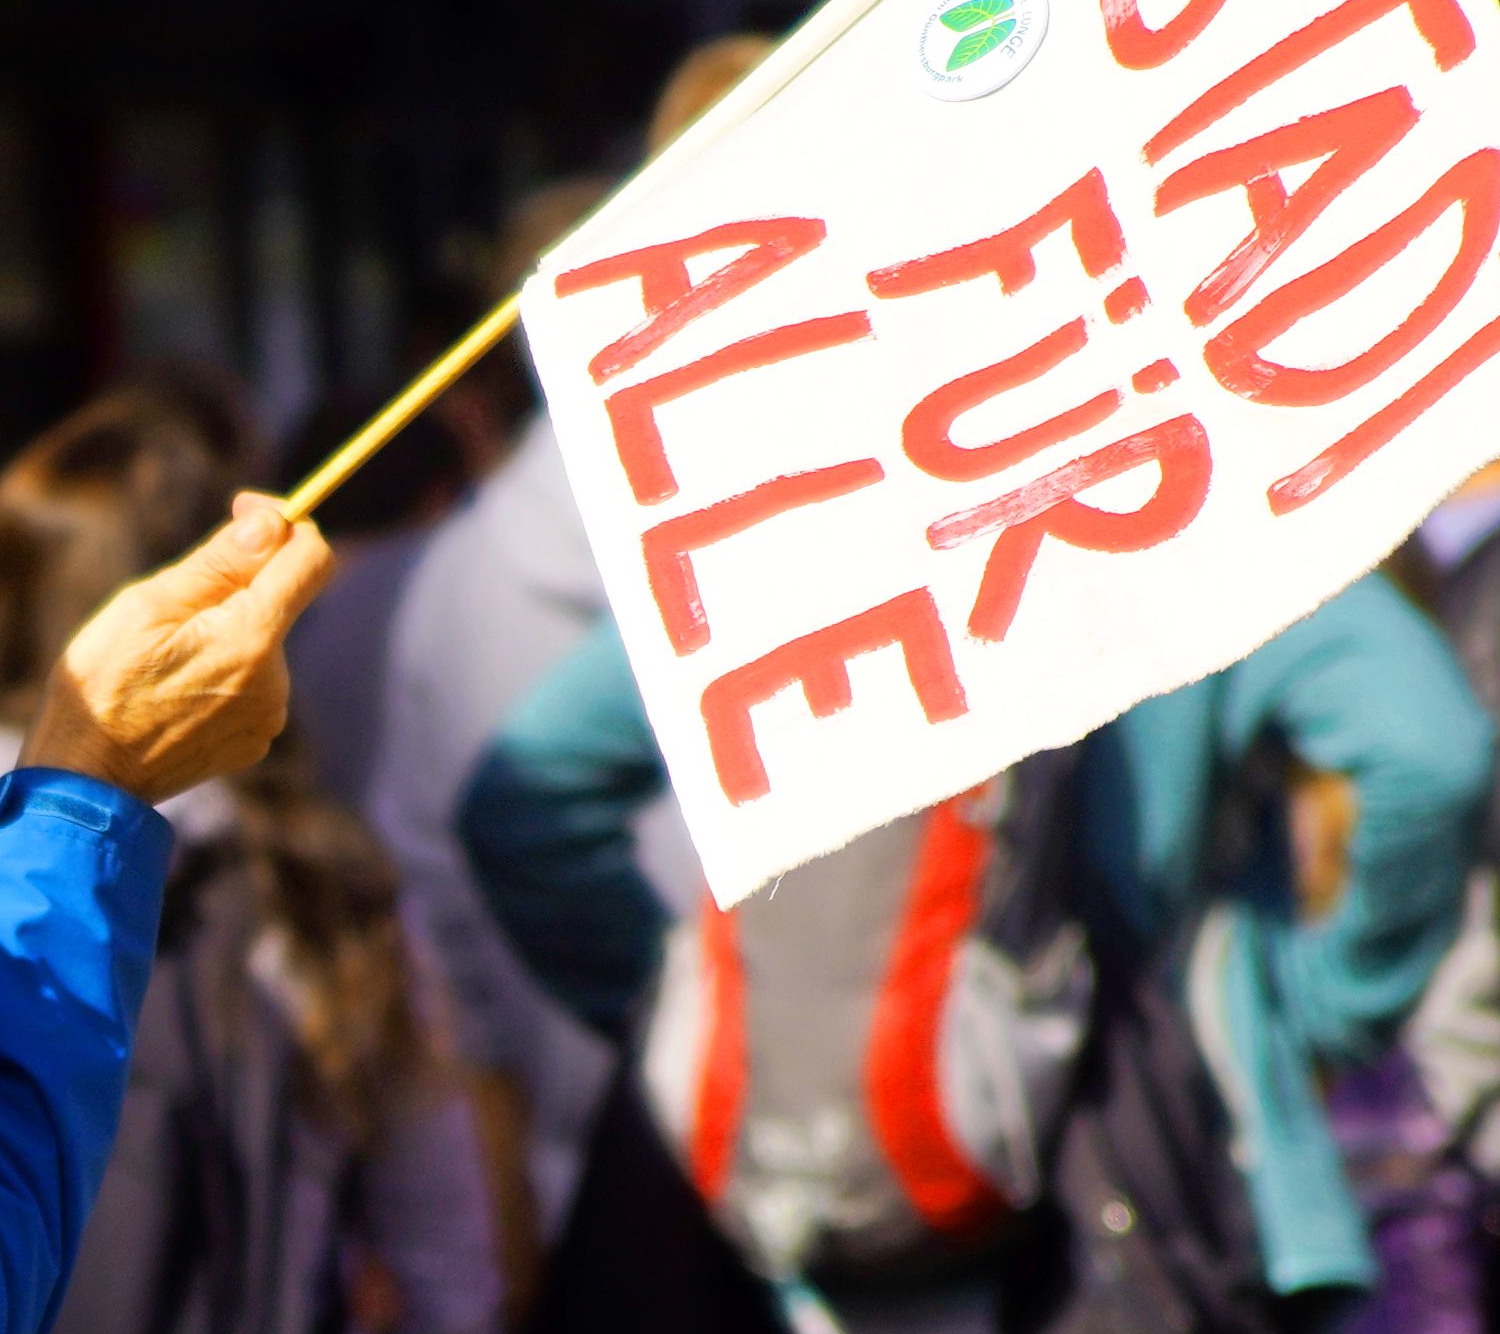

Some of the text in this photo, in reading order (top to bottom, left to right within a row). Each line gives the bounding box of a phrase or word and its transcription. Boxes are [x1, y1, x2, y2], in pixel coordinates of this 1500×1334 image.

[1000, 11, 1032, 59] LUNGE
[555, 216, 970, 807] ALLE
[867, 167, 1212, 643] FÜR
